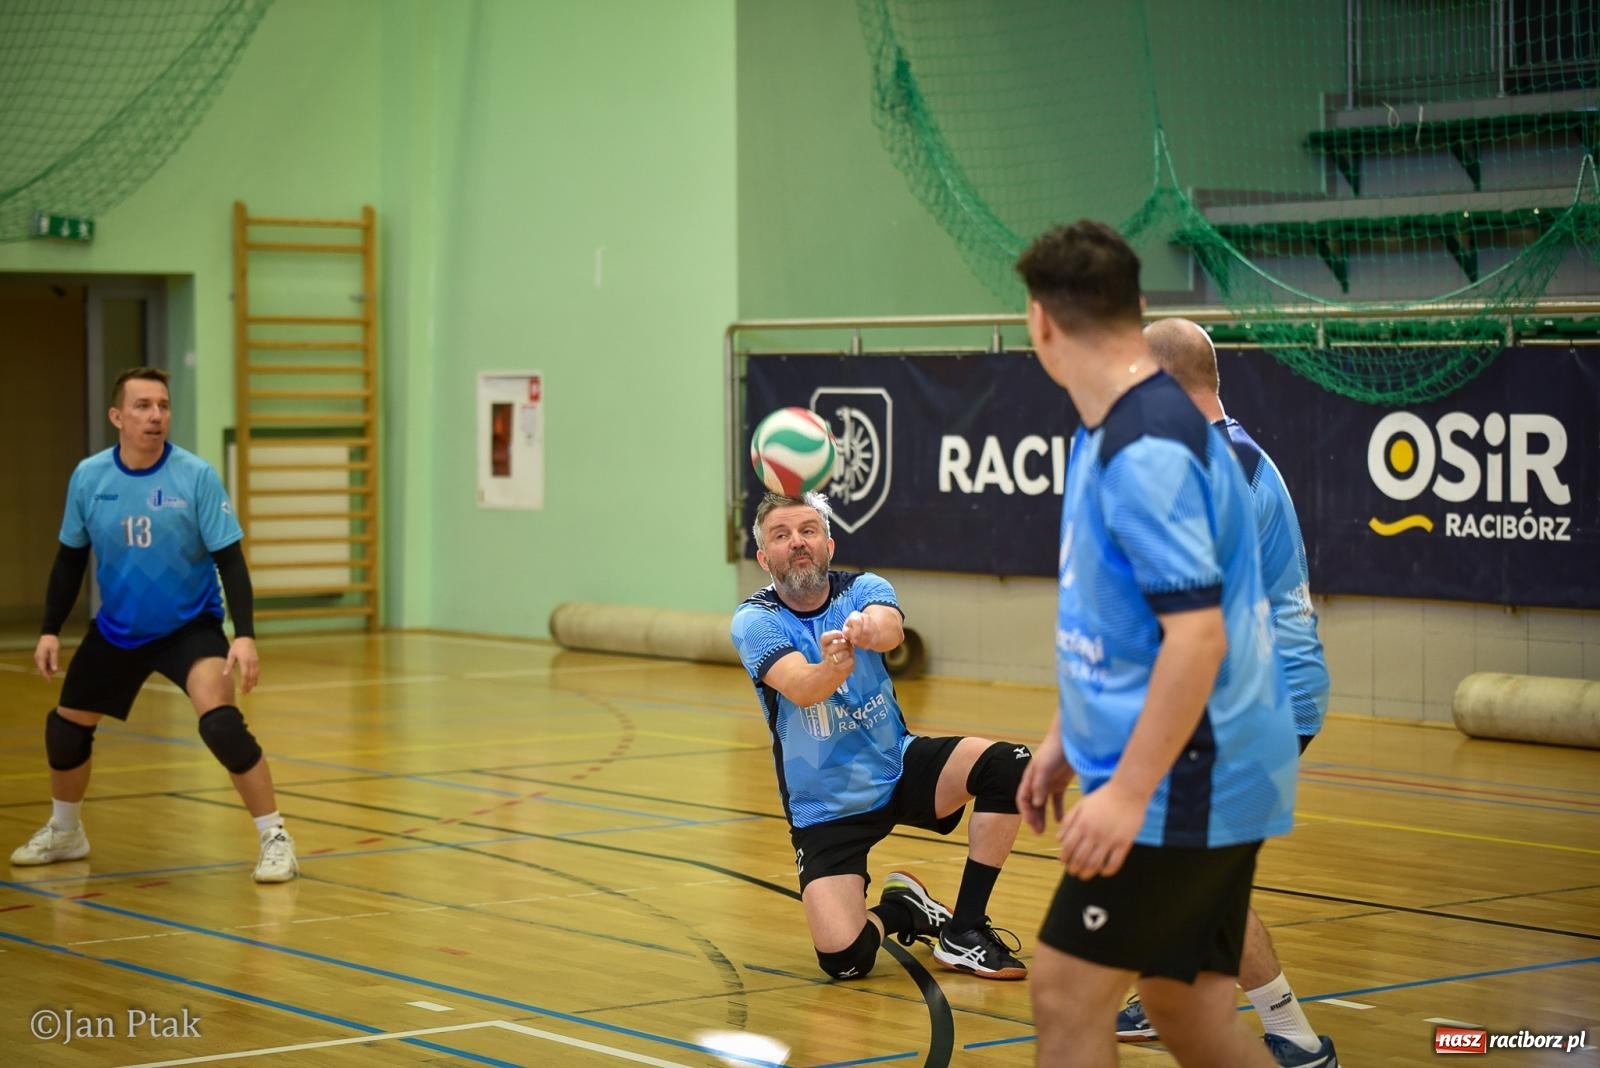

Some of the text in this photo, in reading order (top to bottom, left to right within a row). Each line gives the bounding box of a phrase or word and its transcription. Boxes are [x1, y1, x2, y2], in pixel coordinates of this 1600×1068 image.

[938, 434, 1075, 496] RACI
[1367, 410, 1572, 505] OSiR
[120, 515, 153, 549] 13
[1445, 507, 1572, 542] RACIBÓRZ
